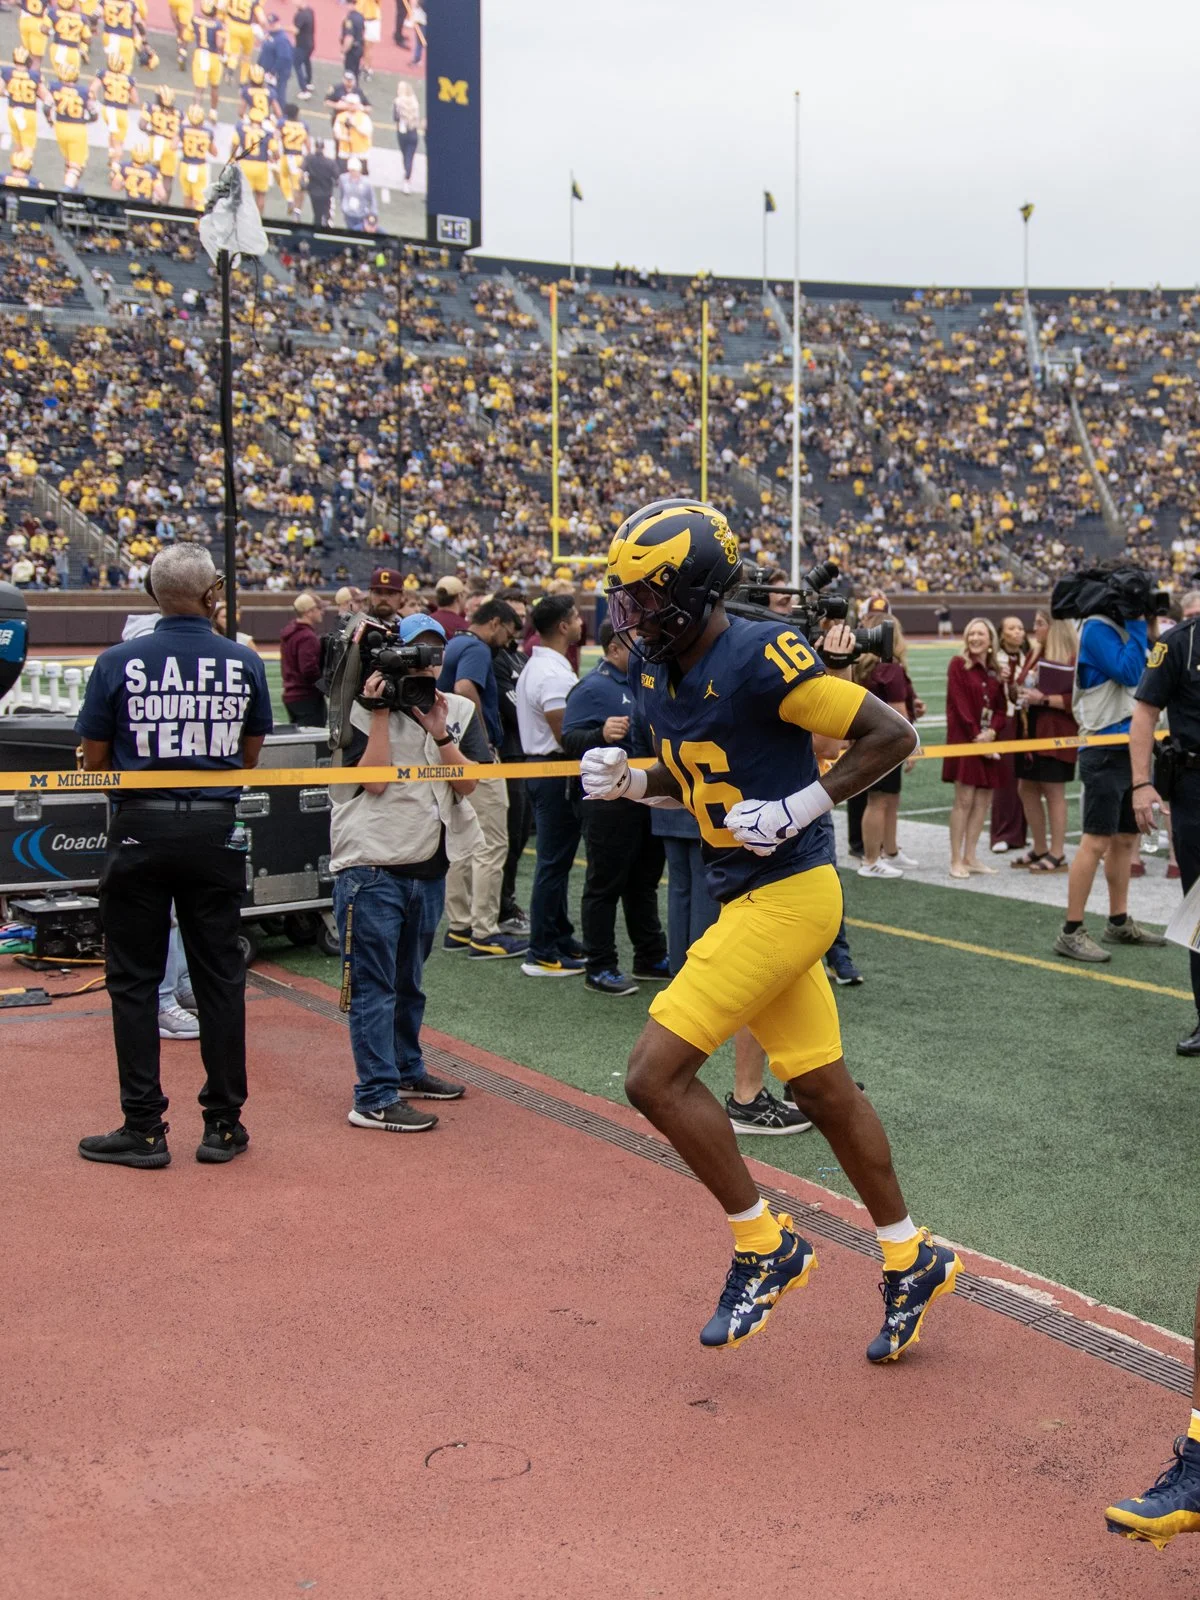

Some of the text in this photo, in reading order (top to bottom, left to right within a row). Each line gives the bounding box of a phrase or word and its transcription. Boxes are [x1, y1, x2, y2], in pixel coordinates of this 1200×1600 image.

[438, 76, 469, 106] M
[380, 571, 390, 584] C
[764, 630, 815, 684] 16
[125, 656, 251, 694] S.A.F.E.
[127, 695, 250, 721] COURTESY
[129, 721, 244, 759] TEAM
[29, 773, 121, 787] M MICHIGAN
[397, 766, 464, 779] M MICHIGAN
